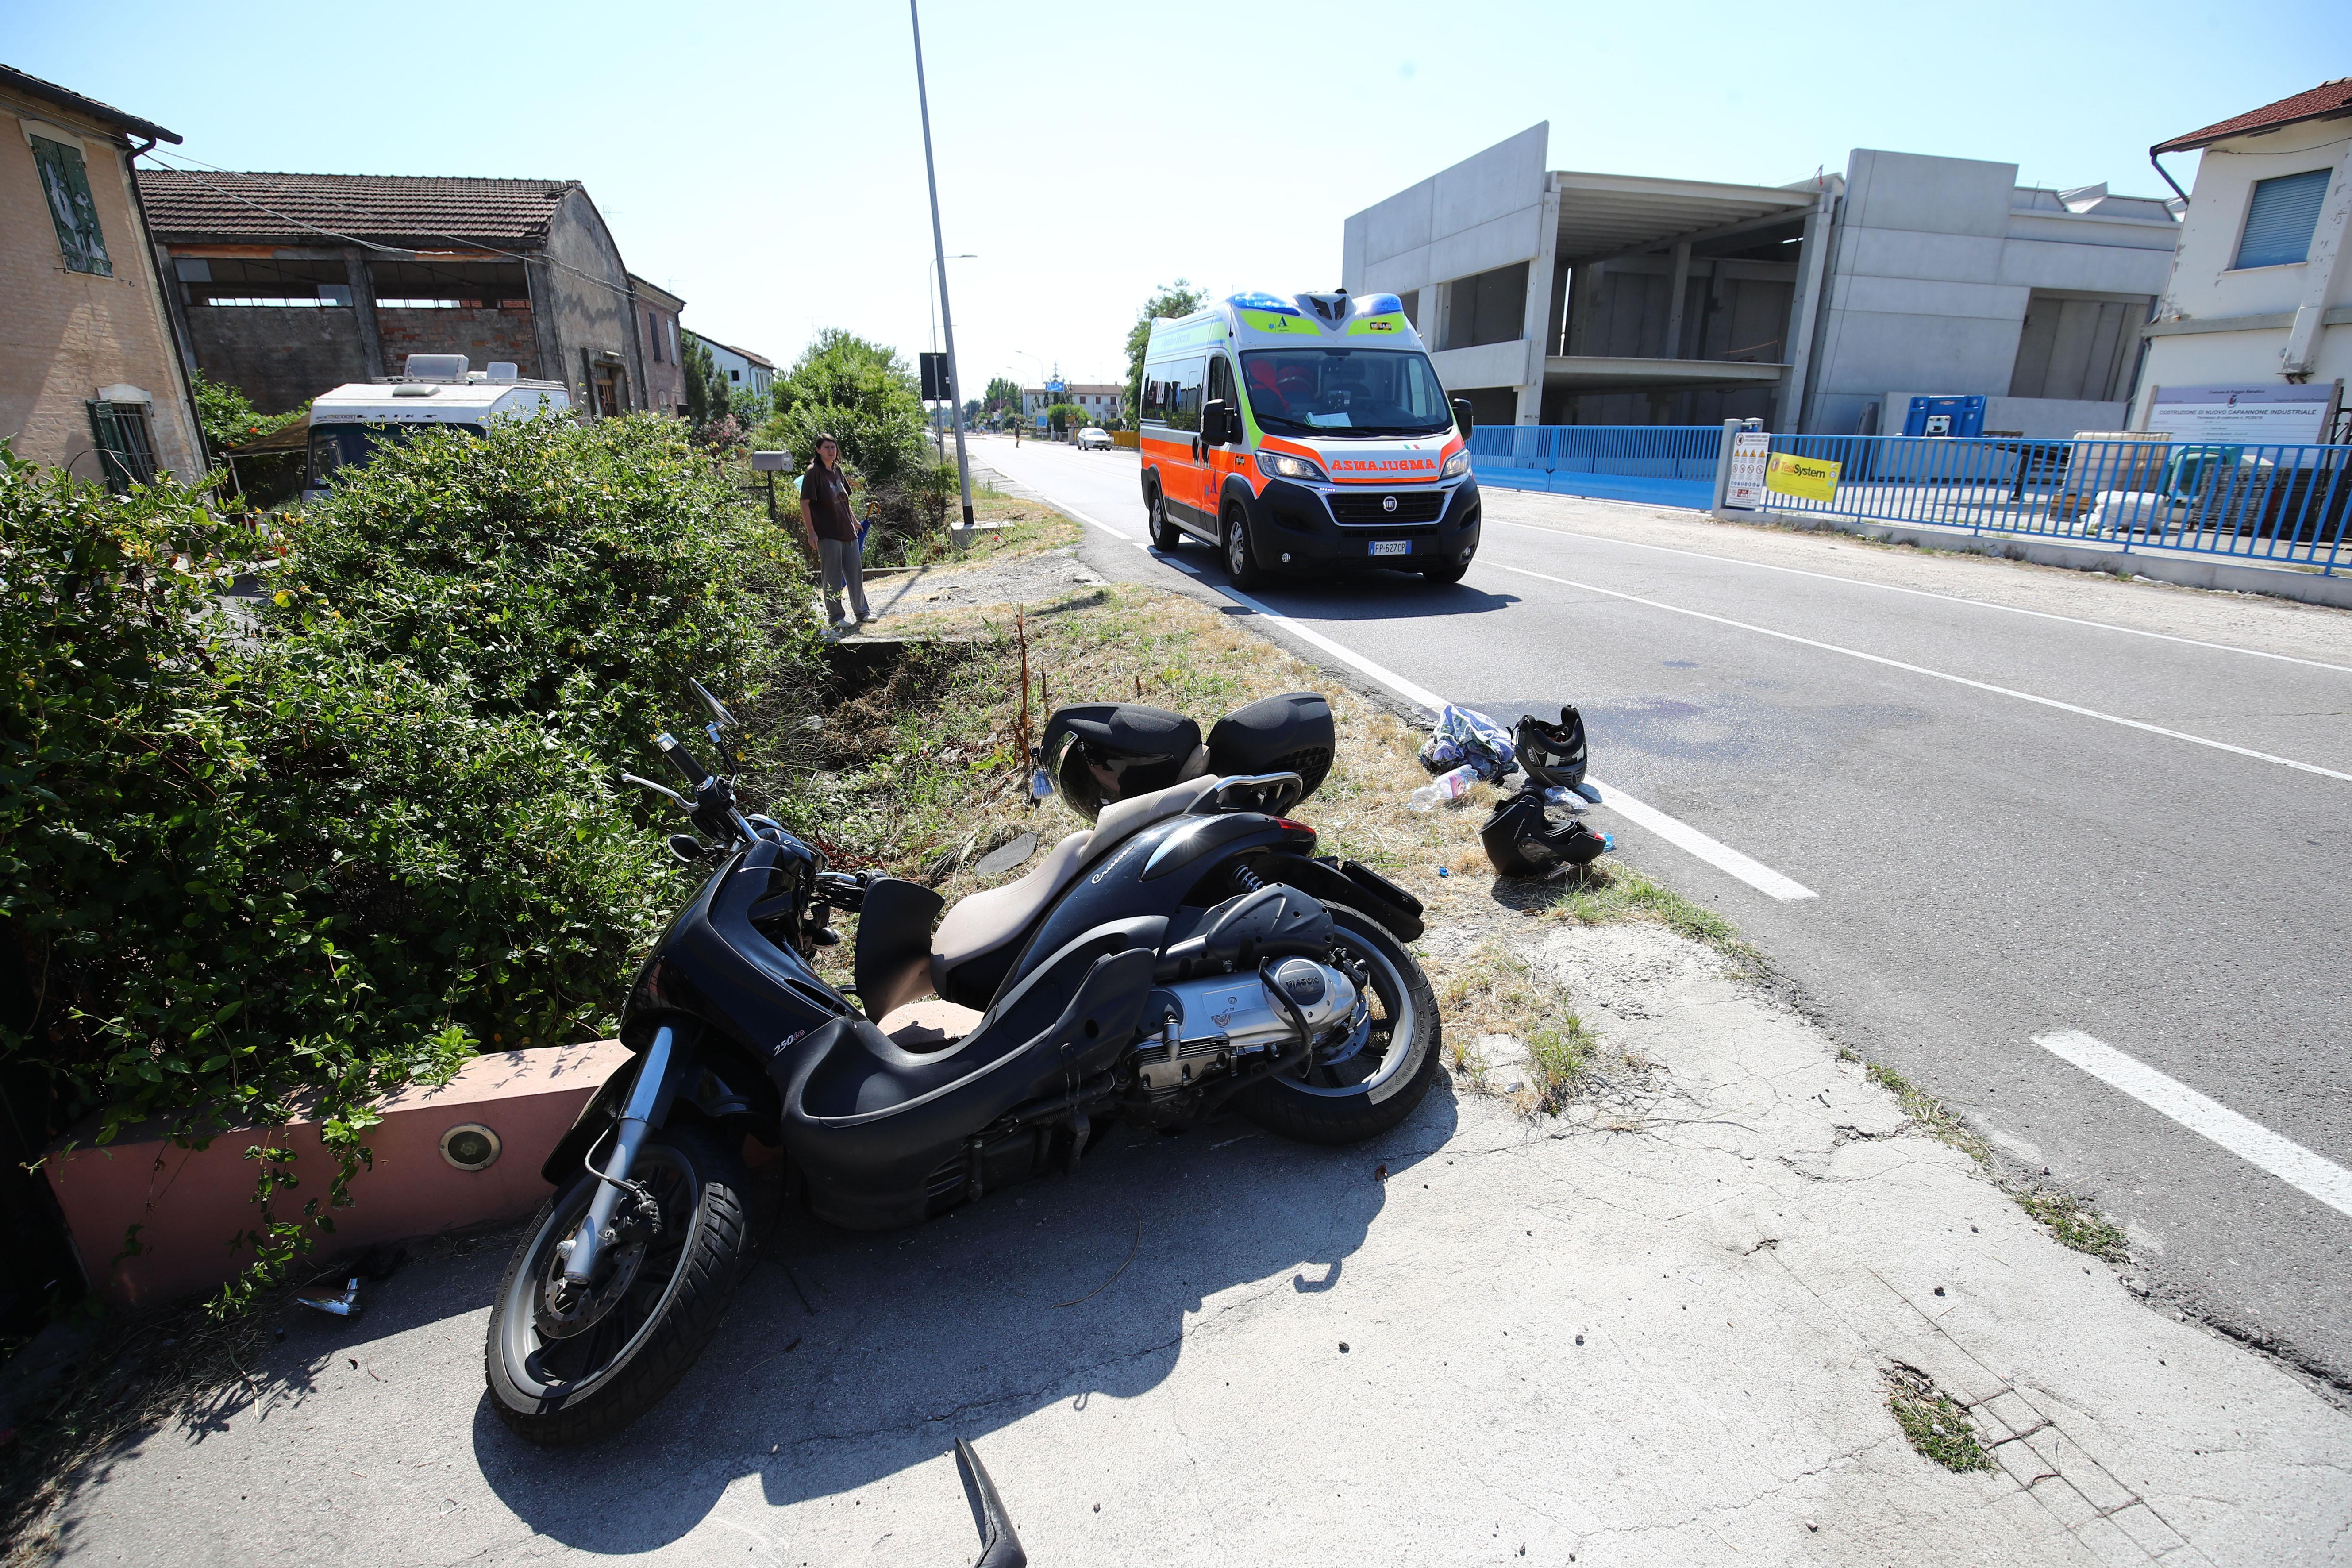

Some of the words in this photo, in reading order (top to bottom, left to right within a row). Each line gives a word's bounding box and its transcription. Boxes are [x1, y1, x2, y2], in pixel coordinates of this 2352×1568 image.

[1781, 461, 1825, 478] TesiSystem
[1091, 844, 1135, 884] Cruiser
[1286, 977, 1319, 990] PIAGGIO
[1370, 1049, 1420, 1101] STANDARD
